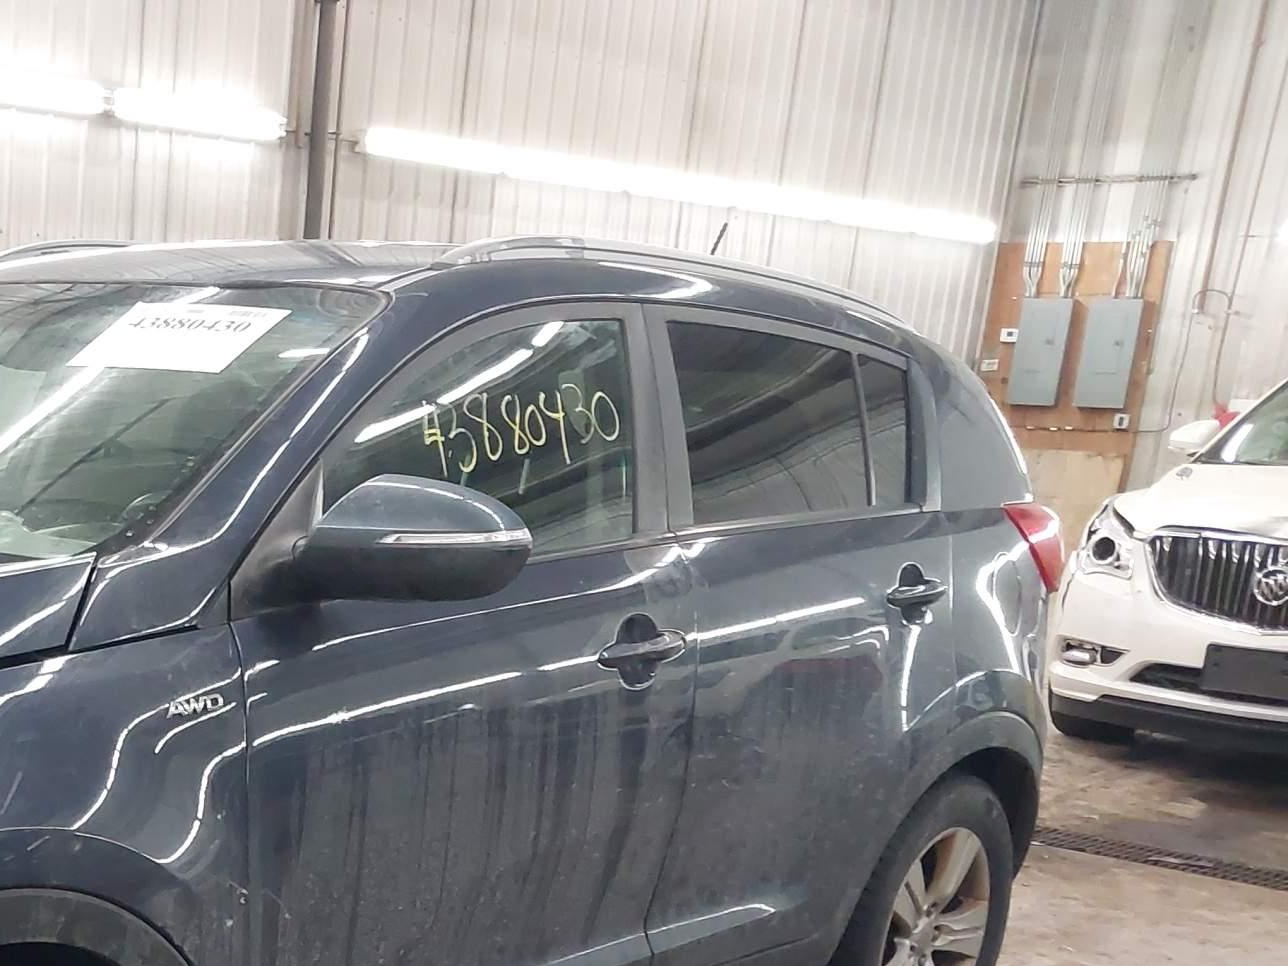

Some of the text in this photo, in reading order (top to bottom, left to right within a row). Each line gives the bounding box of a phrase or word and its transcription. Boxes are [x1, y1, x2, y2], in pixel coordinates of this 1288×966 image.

[128, 316, 252, 333] 43880430
[422, 383, 620, 477] 43880430
[166, 693, 224, 719] AWD
